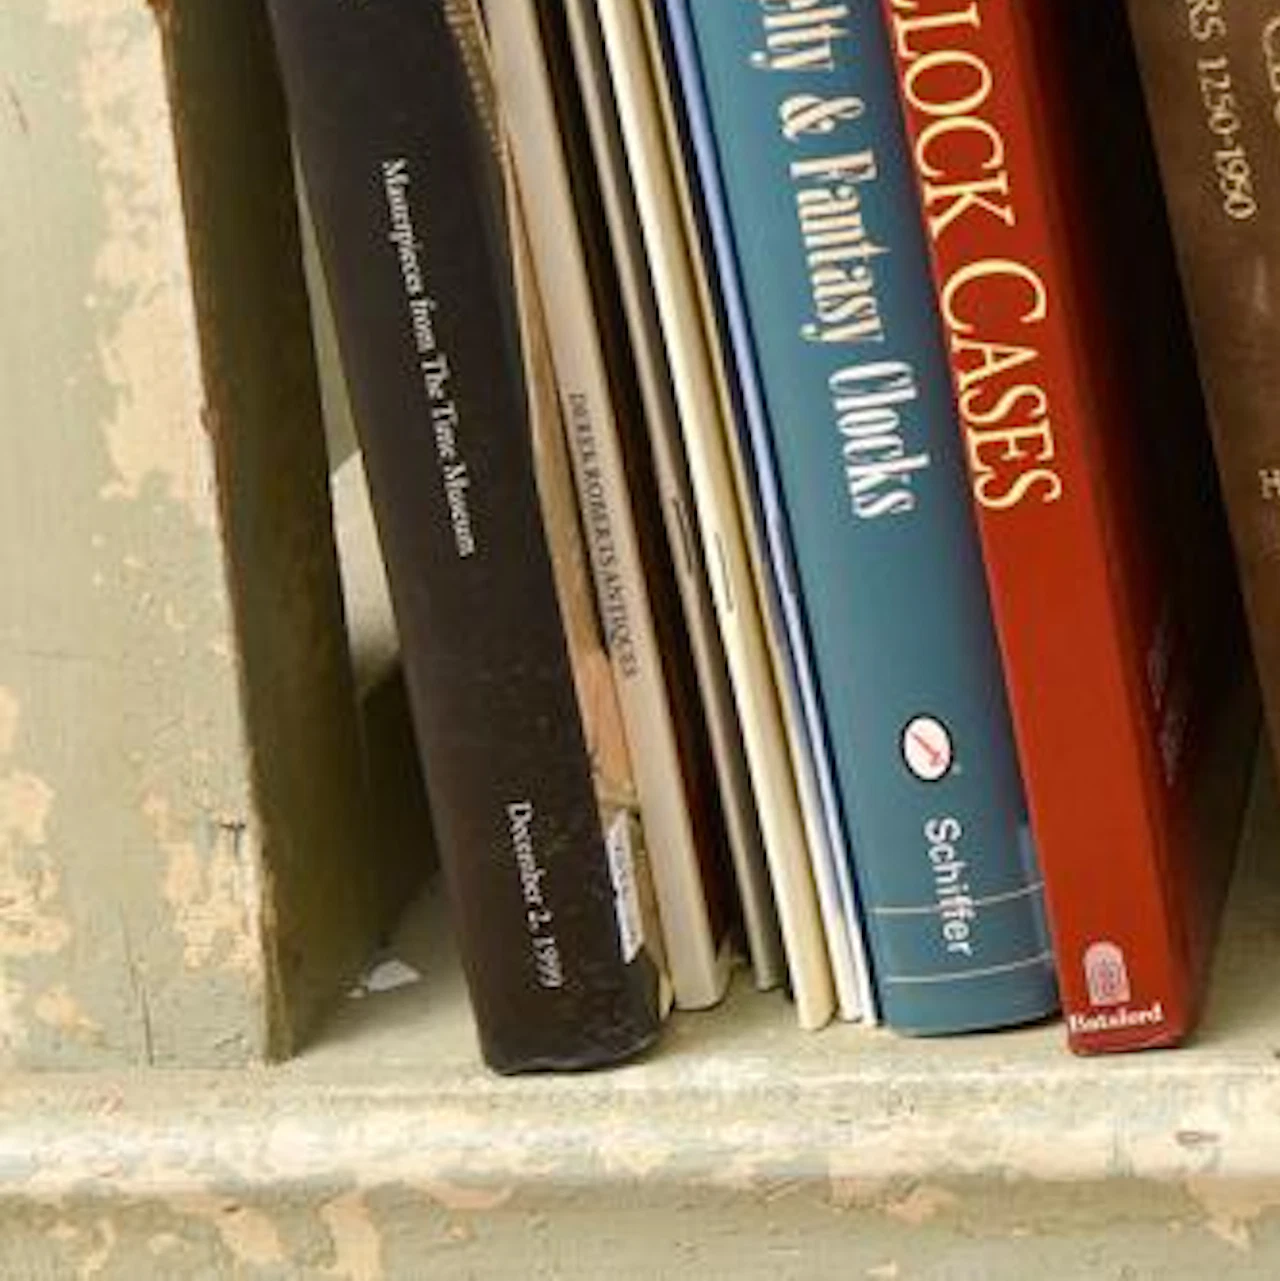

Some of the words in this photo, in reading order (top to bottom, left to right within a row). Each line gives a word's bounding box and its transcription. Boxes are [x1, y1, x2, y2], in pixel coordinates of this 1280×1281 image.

[778, 91, 867, 139] &
[382, 157, 426, 295] Masterpieces
[790, 147, 890, 343] Fantasy
[408, 300, 439, 350] from
[422, 354, 453, 400] The
[939, 258, 1064, 511] CASES
[431, 404, 463, 458] Time
[828, 360, 932, 520] Clocks
[442, 462, 480, 557] Museum
[567, 391, 597, 468] DEREK
[583, 468, 618, 569] ROBERTS
[602, 571, 639, 681] ANTIQUES
[507, 799, 544, 905] December
[532, 935, 565, 990] 1999
[925, 817, 976, 957] Schiffer
